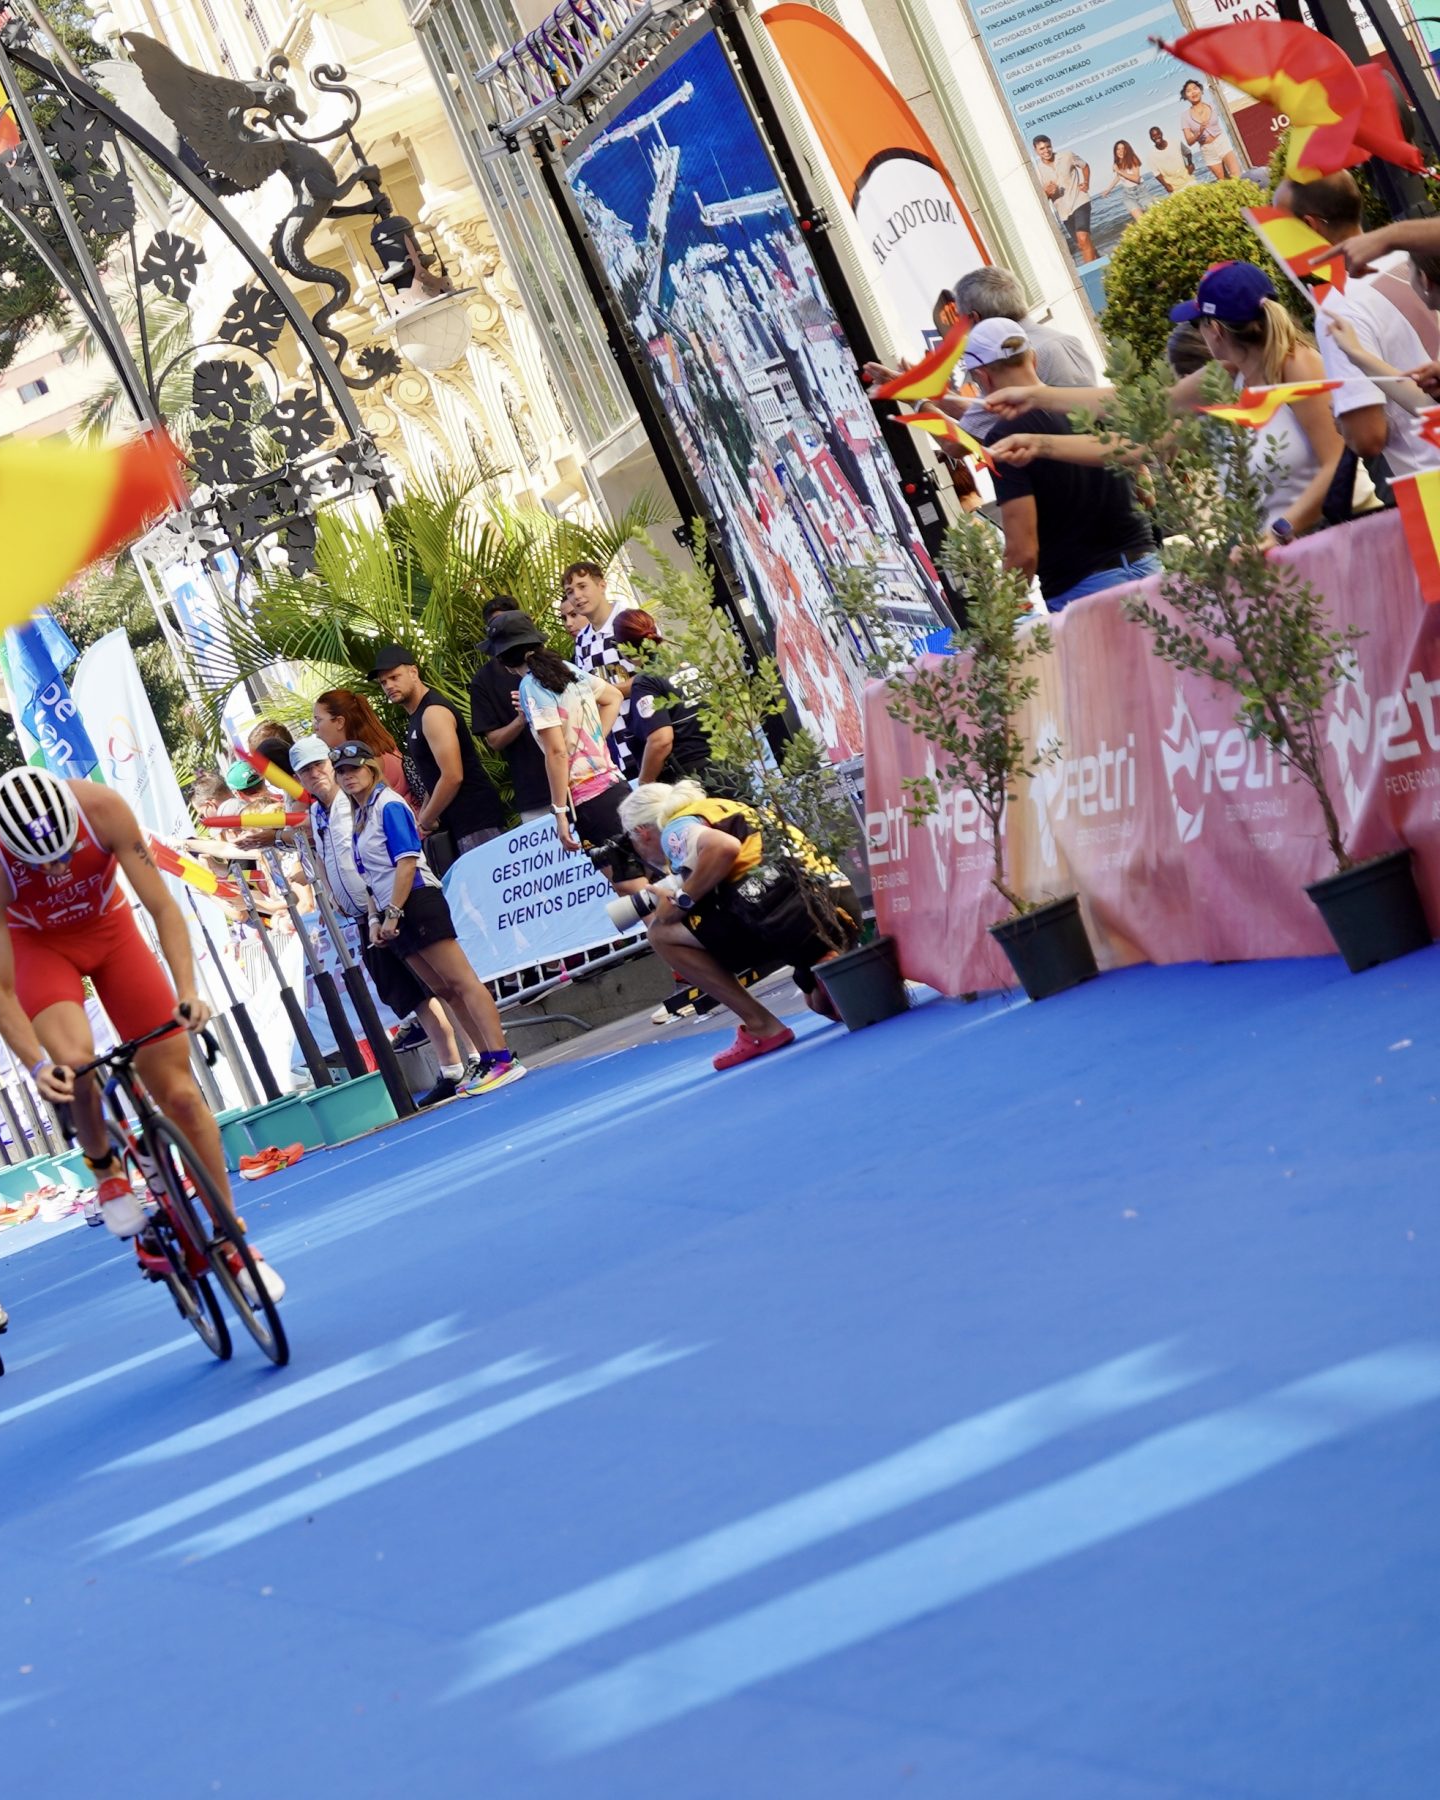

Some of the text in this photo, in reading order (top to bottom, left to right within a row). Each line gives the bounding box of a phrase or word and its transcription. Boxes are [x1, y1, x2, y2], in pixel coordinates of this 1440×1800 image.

[986, 15, 1017, 31] YINCANAS
[1017, 9, 1026, 20] DE
[993, 27, 1032, 48] ACTIVIDADES
[1033, 21, 1042, 31] DE
[1043, 6, 1083, 28] APRENDIZAJE
[1000, 23, 1086, 64] AVISTAMIENTO DE CETÁCEOS
[1006, 69, 1021, 80] GIRA
[1021, 63, 1035, 75] LOS
[1043, 44, 1082, 65] PRINCIPALES
[1012, 58, 1092, 97] CAMPO DE VOLUNTARIADO
[1018, 88, 1066, 113] CAMPAMENTOS
[1065, 73, 1101, 94] INFANTILES
[1105, 58, 1139, 77] JUVENILES
[1025, 78, 1136, 129] DÍA INTERNACIONAL DE LA JUVENTUD
[1056, 733, 1135, 820] Fetri
[29, 819, 53, 839] 31
[492, 850, 553, 884] GESTIÓN
[498, 896, 563, 931] EVENTOS
